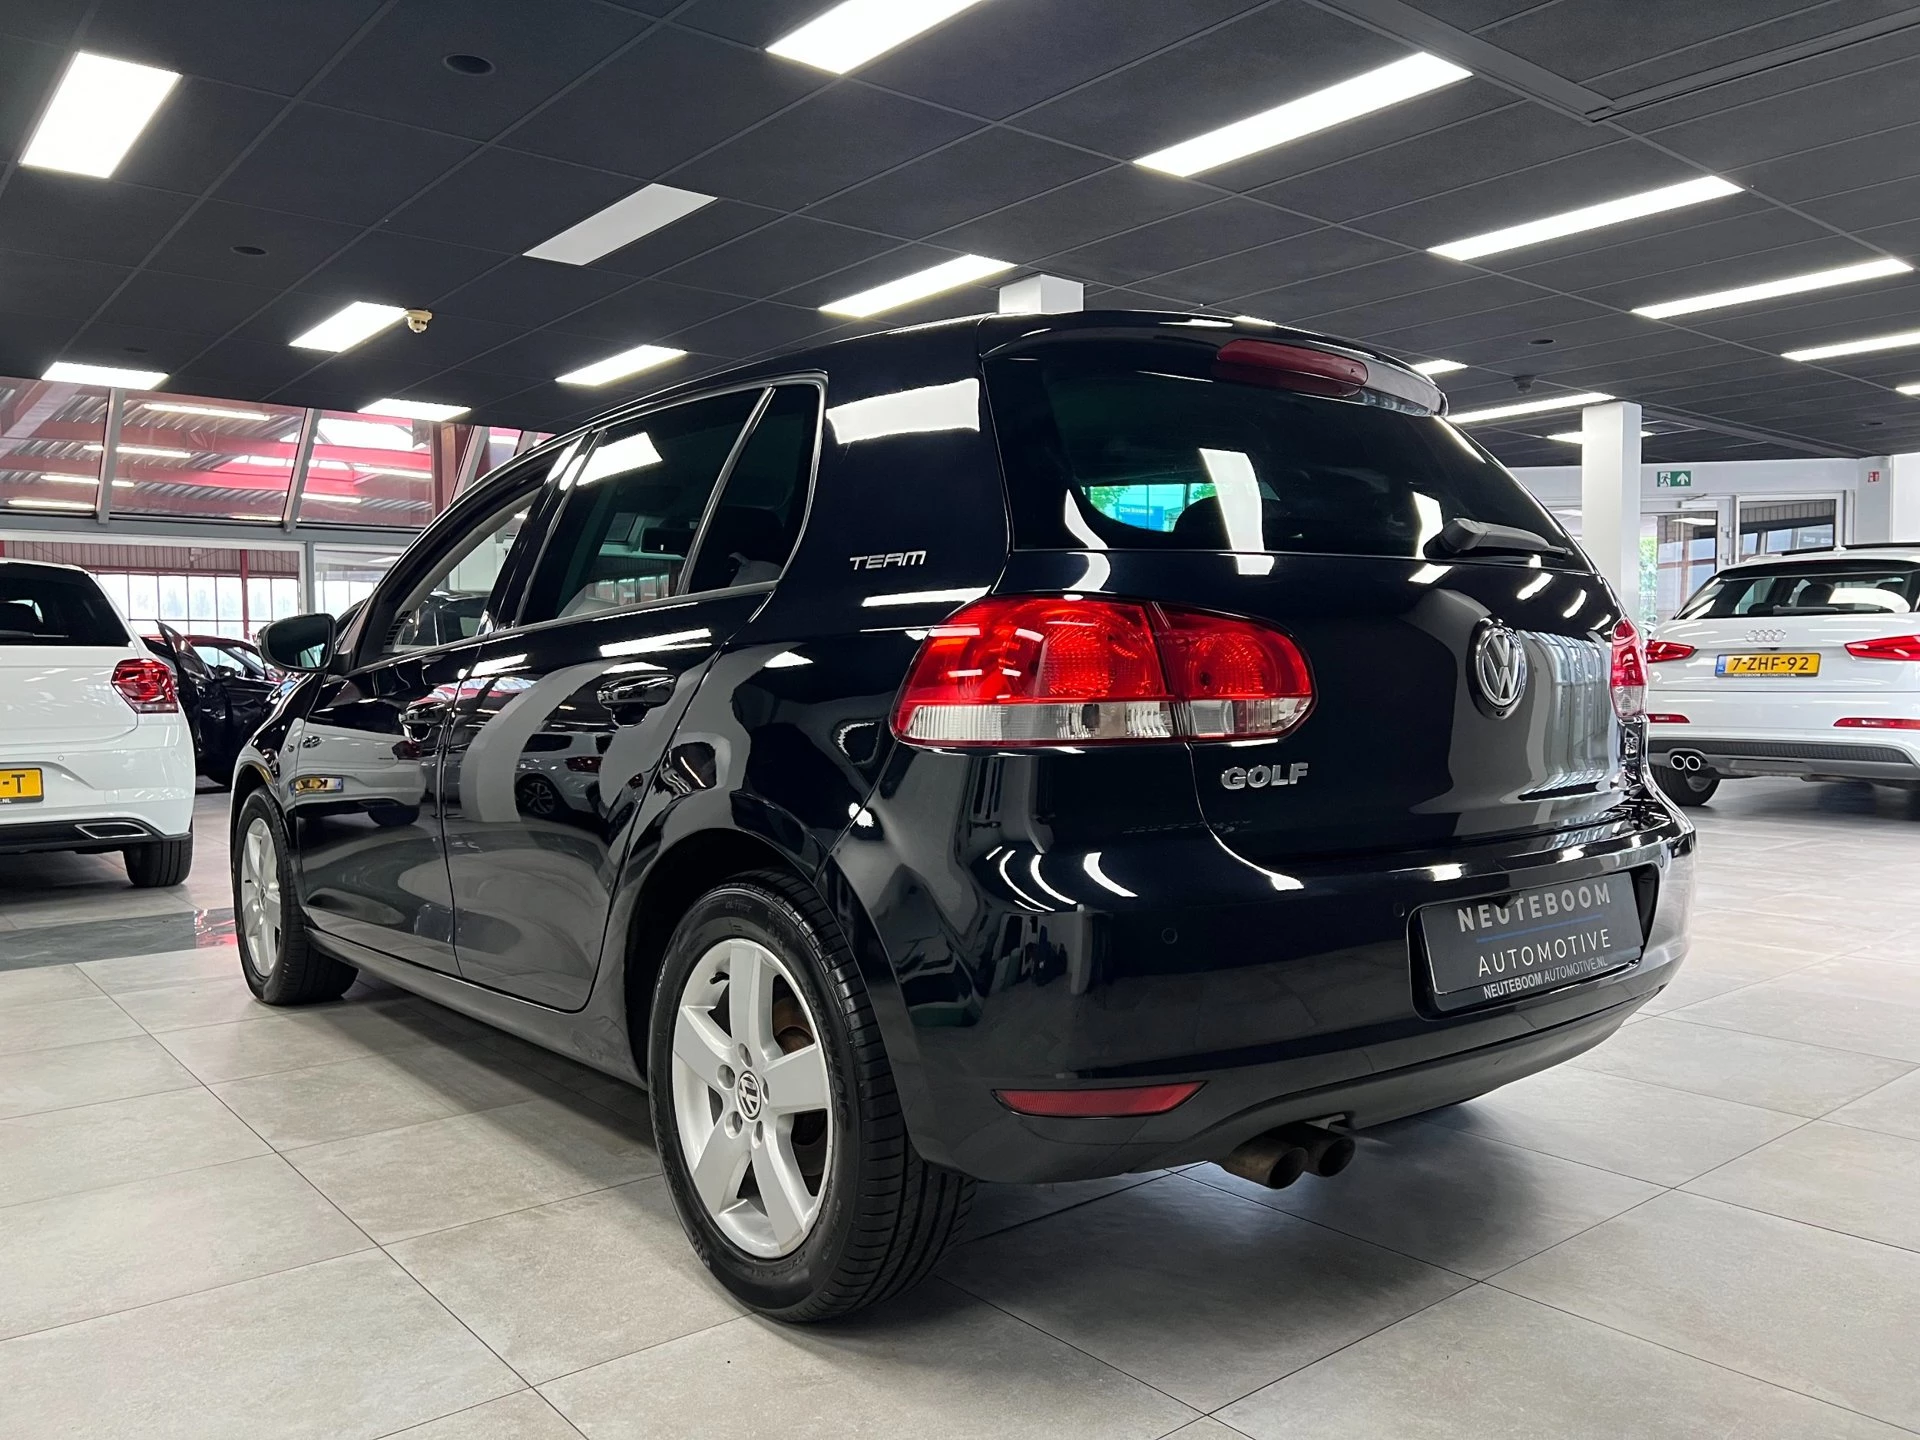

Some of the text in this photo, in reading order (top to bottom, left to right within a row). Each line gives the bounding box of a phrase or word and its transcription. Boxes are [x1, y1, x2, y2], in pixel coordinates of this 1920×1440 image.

[849, 550, 927, 570] TEAM
[1732, 656, 1809, 672] 7-ZHF-92
[1221, 762, 1309, 790] GOLF
[1457, 882, 1611, 933] NEUTEBOOM
[1478, 929, 1611, 978] AUTOMOTIVE
[1483, 956, 1609, 999] NEUTEBOOM AUTOMOTIVE.NL
